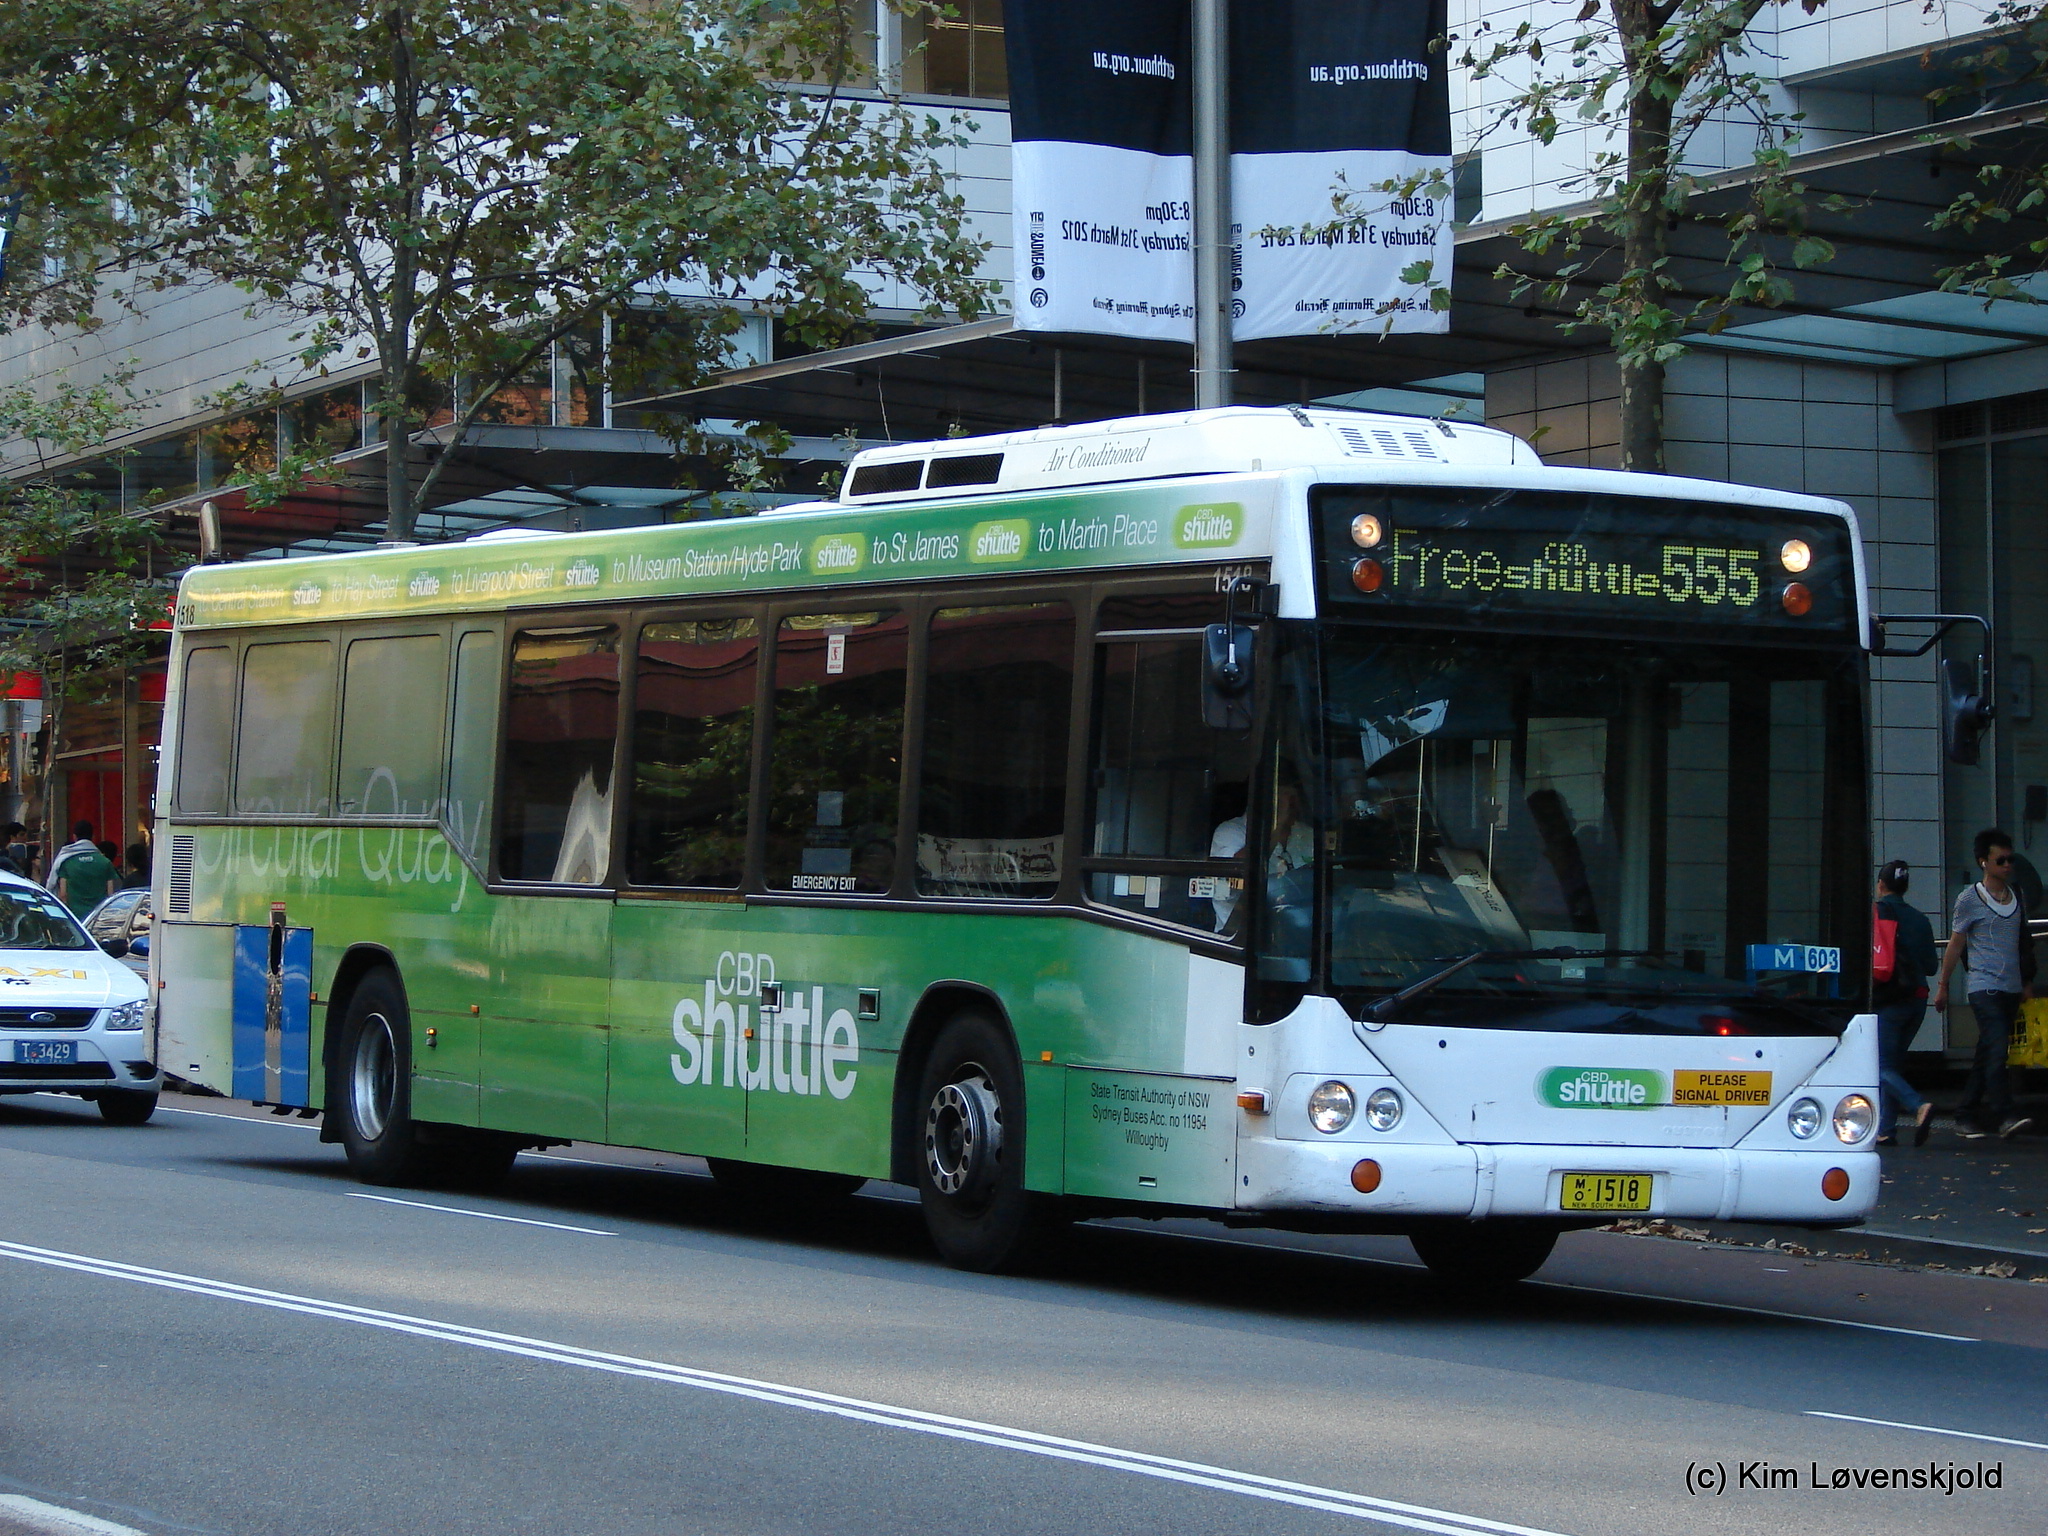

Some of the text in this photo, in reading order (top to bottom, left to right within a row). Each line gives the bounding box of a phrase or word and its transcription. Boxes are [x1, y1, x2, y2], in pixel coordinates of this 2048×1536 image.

[1041, 437, 1151, 473] Air Conditioned
[1038, 514, 1158, 552] to Martin Place
[1183, 514, 1233, 542] shuttle
[817, 542, 857, 569] shuttle
[872, 533, 959, 564] to St James
[976, 530, 1021, 556] shuttle
[1546, 542, 1587, 567] CBD
[566, 564, 600, 586] shuttle
[612, 558, 625, 583] to
[627, 554, 682, 582] Museum
[770, 541, 802, 571] Park
[1663, 544, 1759, 605] 555
[409, 575, 440, 597] shuttle
[452, 562, 555, 597] to Liverpool Street
[293, 586, 322, 605] shuttle
[177, 604, 195, 625] 1518
[357, 766, 484, 913] Quay
[792, 875, 856, 891] EMERGENCY EXIT
[1808, 947, 1838, 970] 603
[716, 950, 775, 996] CBD
[38, 1043, 70, 1059] 3429
[670, 979, 859, 1100] shuttle
[1581, 1071, 1609, 1083] CBD
[1699, 1074, 1747, 1086] PLEASE
[1091, 1082, 1210, 1109] State Transit Authority of NSW
[1559, 1078, 1646, 1104] shuttle
[1675, 1090, 1769, 1102] SIGNAL DRIVER
[1092, 1104, 1207, 1130] Sydney Buses Acc. no 11954
[1125, 1128, 1170, 1152] Willoughby
[1596, 1179, 1639, 1202] 1518
